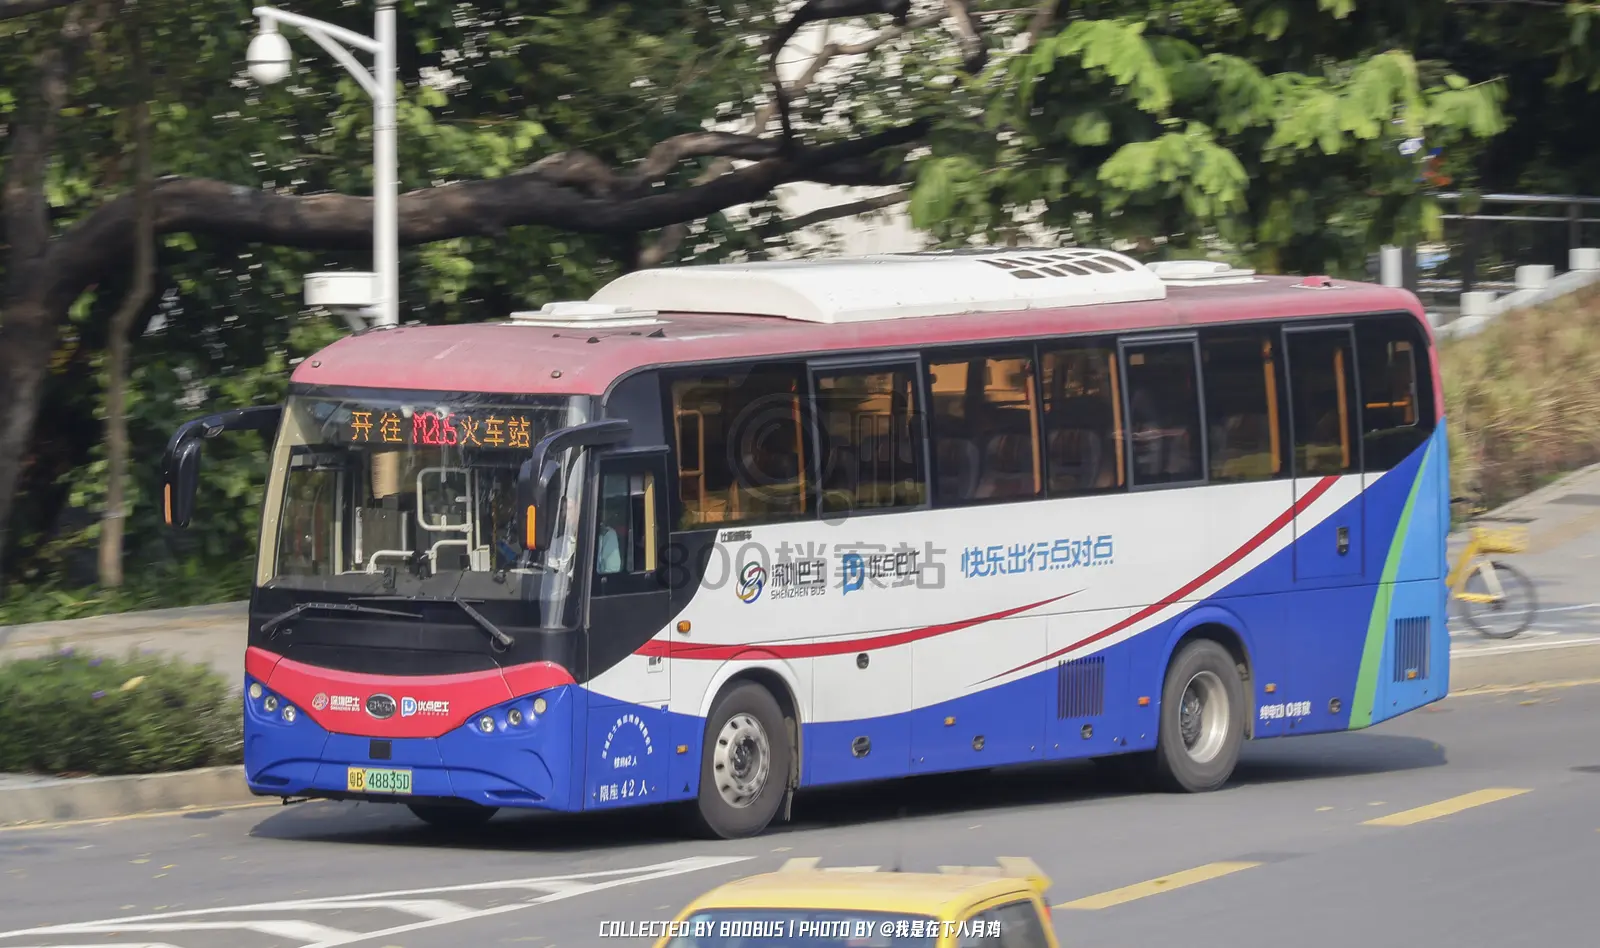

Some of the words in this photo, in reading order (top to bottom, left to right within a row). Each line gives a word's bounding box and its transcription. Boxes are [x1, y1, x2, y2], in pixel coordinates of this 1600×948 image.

[351, 411, 403, 442] 开往
[460, 415, 532, 448] 火车站
[869, 550, 920, 579] 优点巴士
[960, 534, 1114, 579] 快乐出行点对点
[771, 560, 825, 587] 深圳巴士
[771, 587, 809, 600] SHENZHEN
[810, 585, 826, 597] BUS
[417, 700, 450, 713] 优点巴士
[368, 772, 410, 790] 48835D
[600, 783, 618, 802] 限座
[620, 779, 635, 798] 42
[637, 780, 648, 797] 人
